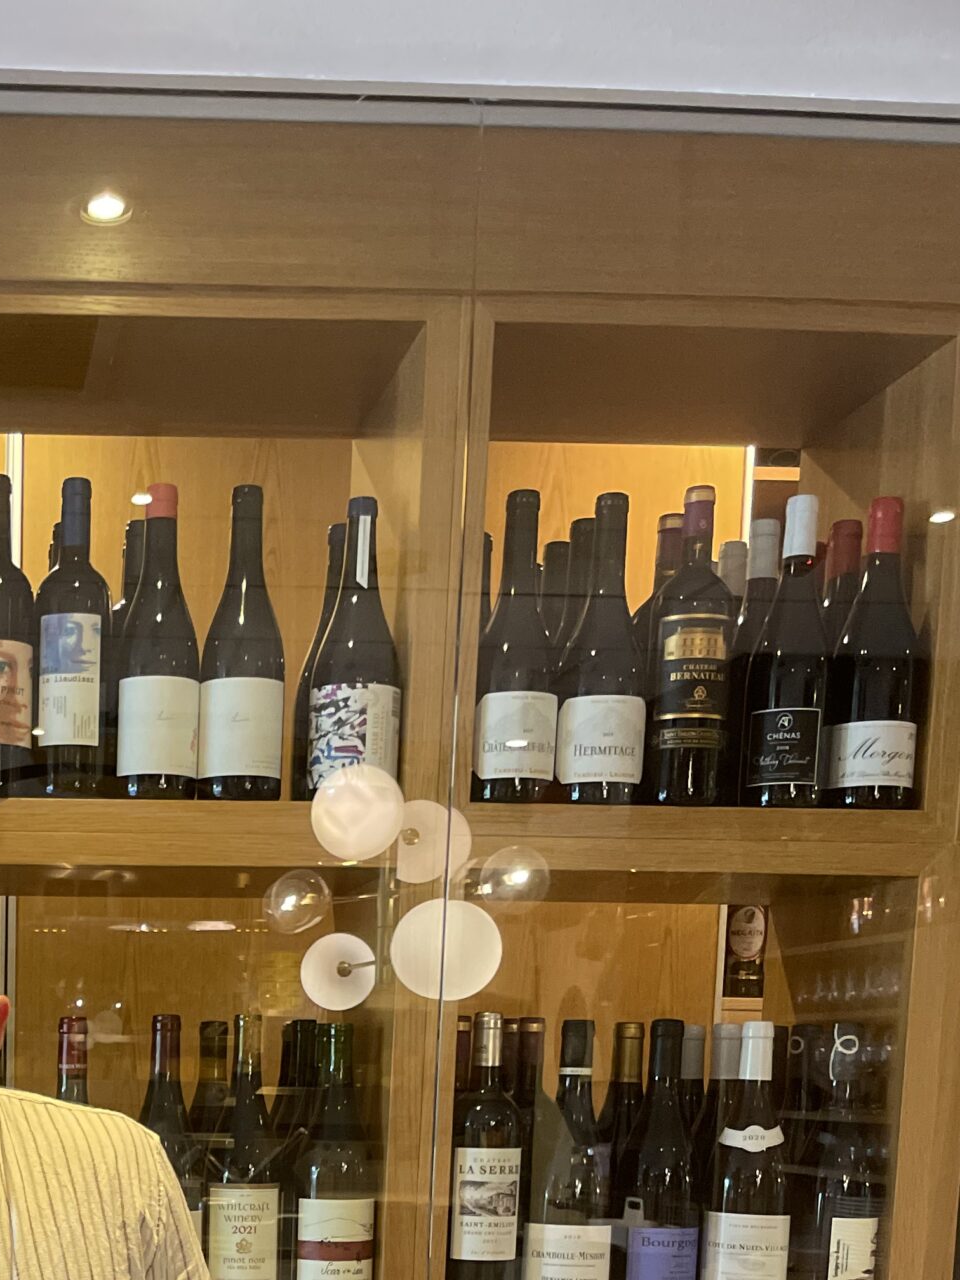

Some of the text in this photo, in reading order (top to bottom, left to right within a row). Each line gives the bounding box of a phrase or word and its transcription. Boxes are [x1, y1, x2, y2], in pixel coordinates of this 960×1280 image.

[766, 730, 801, 741] CHÉNAS
[573, 743, 637, 758] HERMITAGE
[459, 1164, 474, 1175] LA
[231, 1224, 257, 1235] 2021
